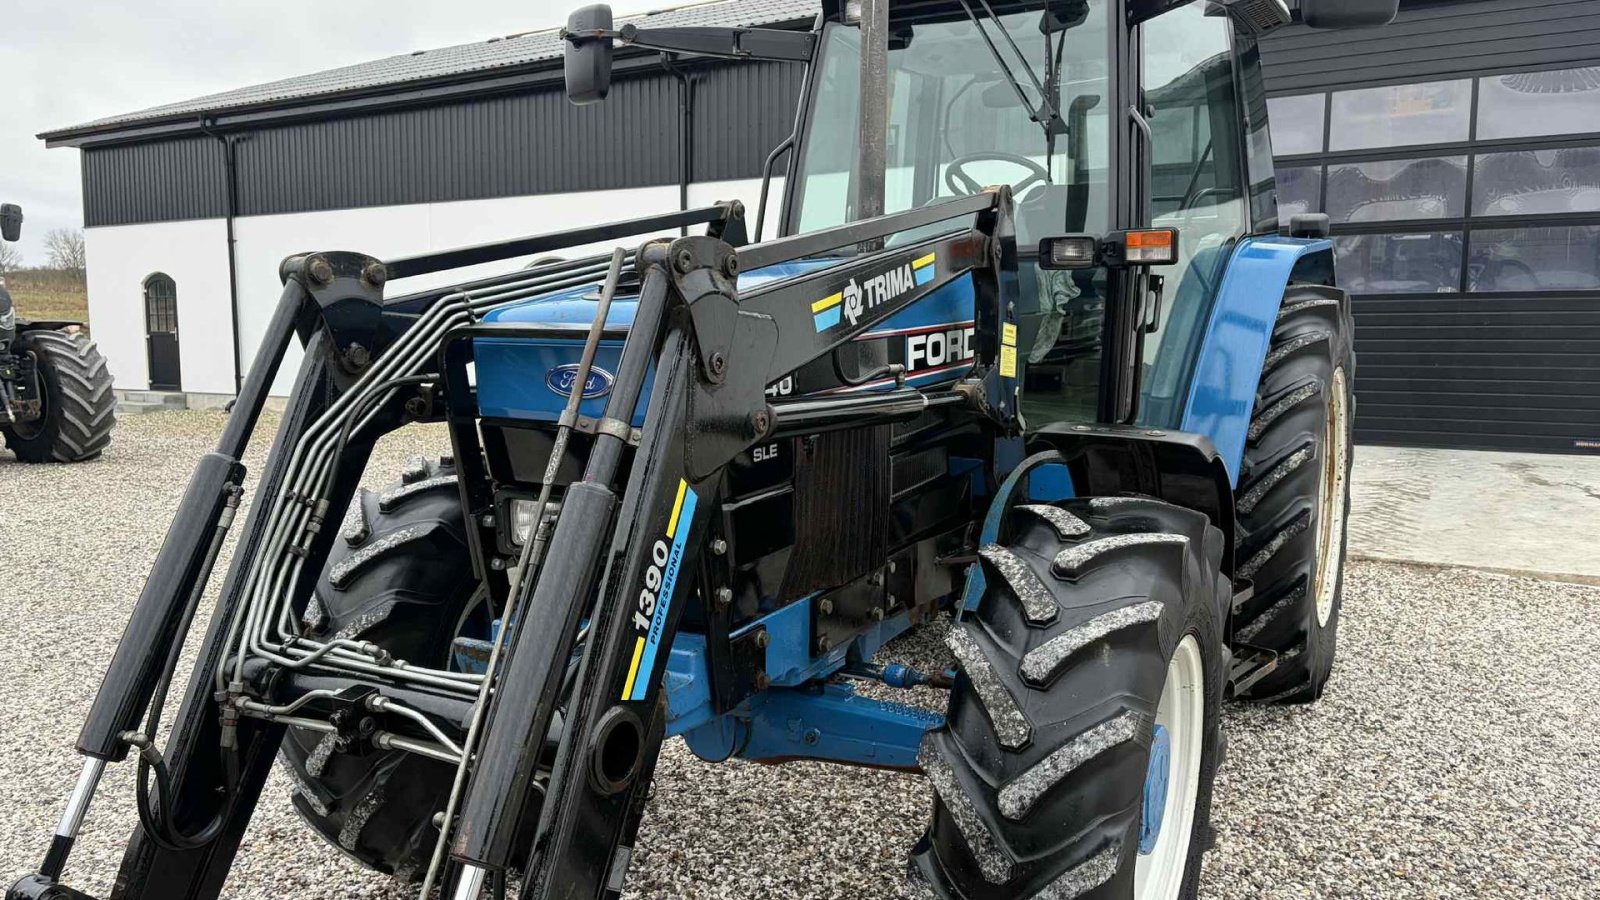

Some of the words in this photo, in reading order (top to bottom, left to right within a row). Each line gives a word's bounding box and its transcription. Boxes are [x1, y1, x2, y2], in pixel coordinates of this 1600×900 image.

[863, 263, 915, 309] TRIMA
[753, 443, 778, 462] SLE
[632, 539, 669, 631] 1390
[650, 541, 682, 645] PROFESSIONAL
